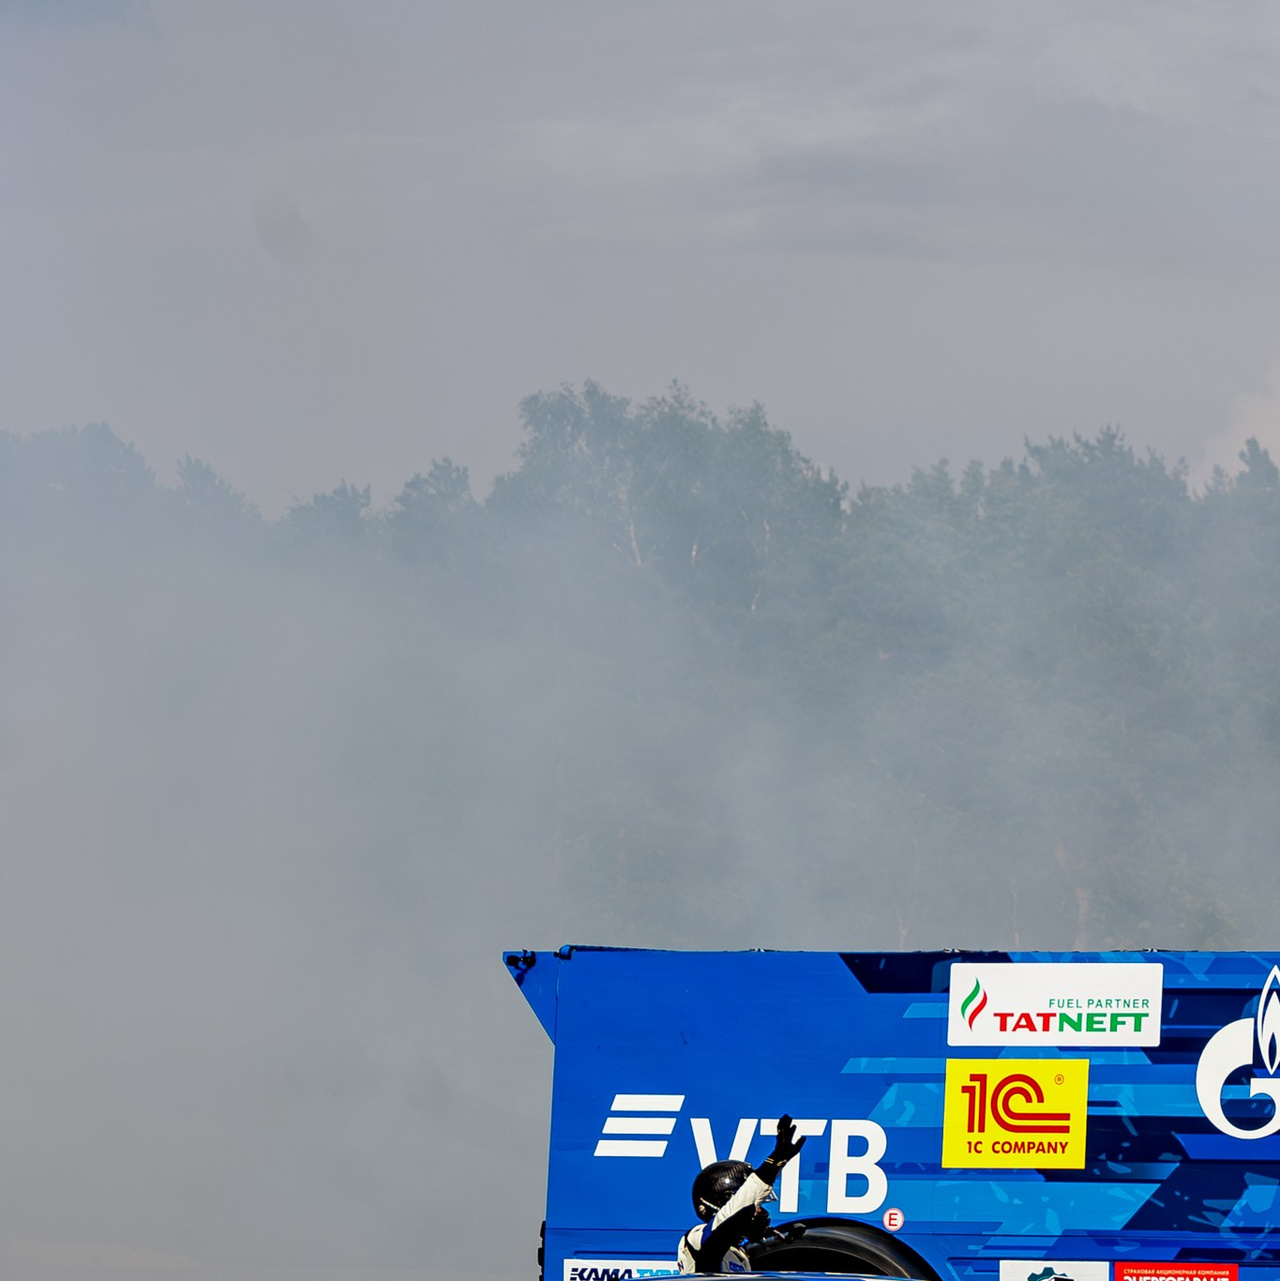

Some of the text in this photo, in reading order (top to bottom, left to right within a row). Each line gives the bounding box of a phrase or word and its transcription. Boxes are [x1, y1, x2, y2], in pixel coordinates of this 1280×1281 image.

[1049, 998, 1150, 1009] FUEL PARTNER
[993, 1012, 1150, 1033] TATNEFT
[967, 1140, 1070, 1154] 1C COMPANY
